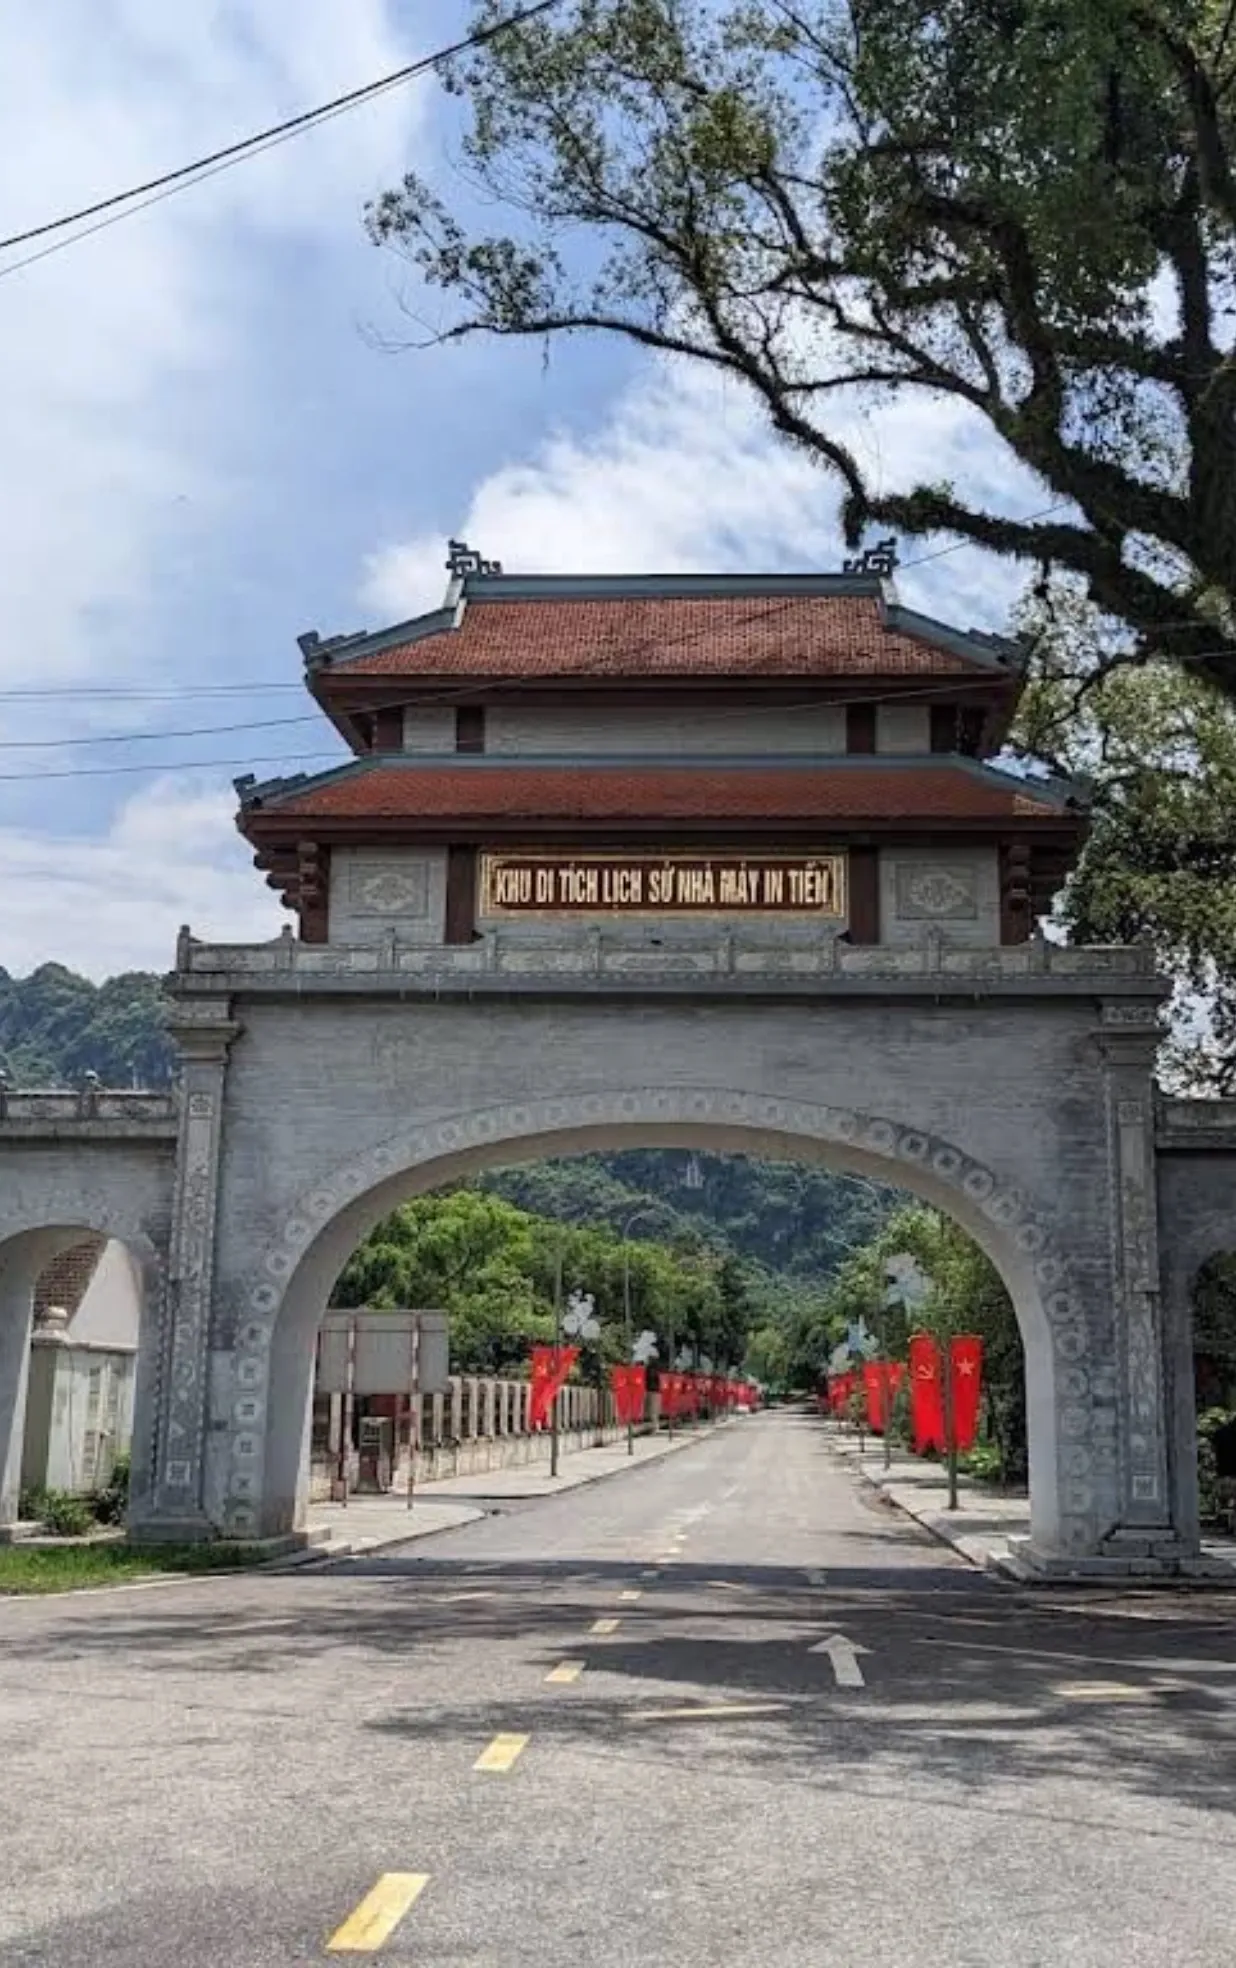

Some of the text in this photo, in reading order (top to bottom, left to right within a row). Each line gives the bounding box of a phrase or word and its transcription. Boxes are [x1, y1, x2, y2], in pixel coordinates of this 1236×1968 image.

[497, 868, 532, 904] KHU
[536, 868, 555, 904] DI
[559, 861, 598, 904] TÍCH
[603, 868, 642, 909] LỊCH
[720, 861, 759, 904] MÁY
[764, 868, 783, 904] IN
